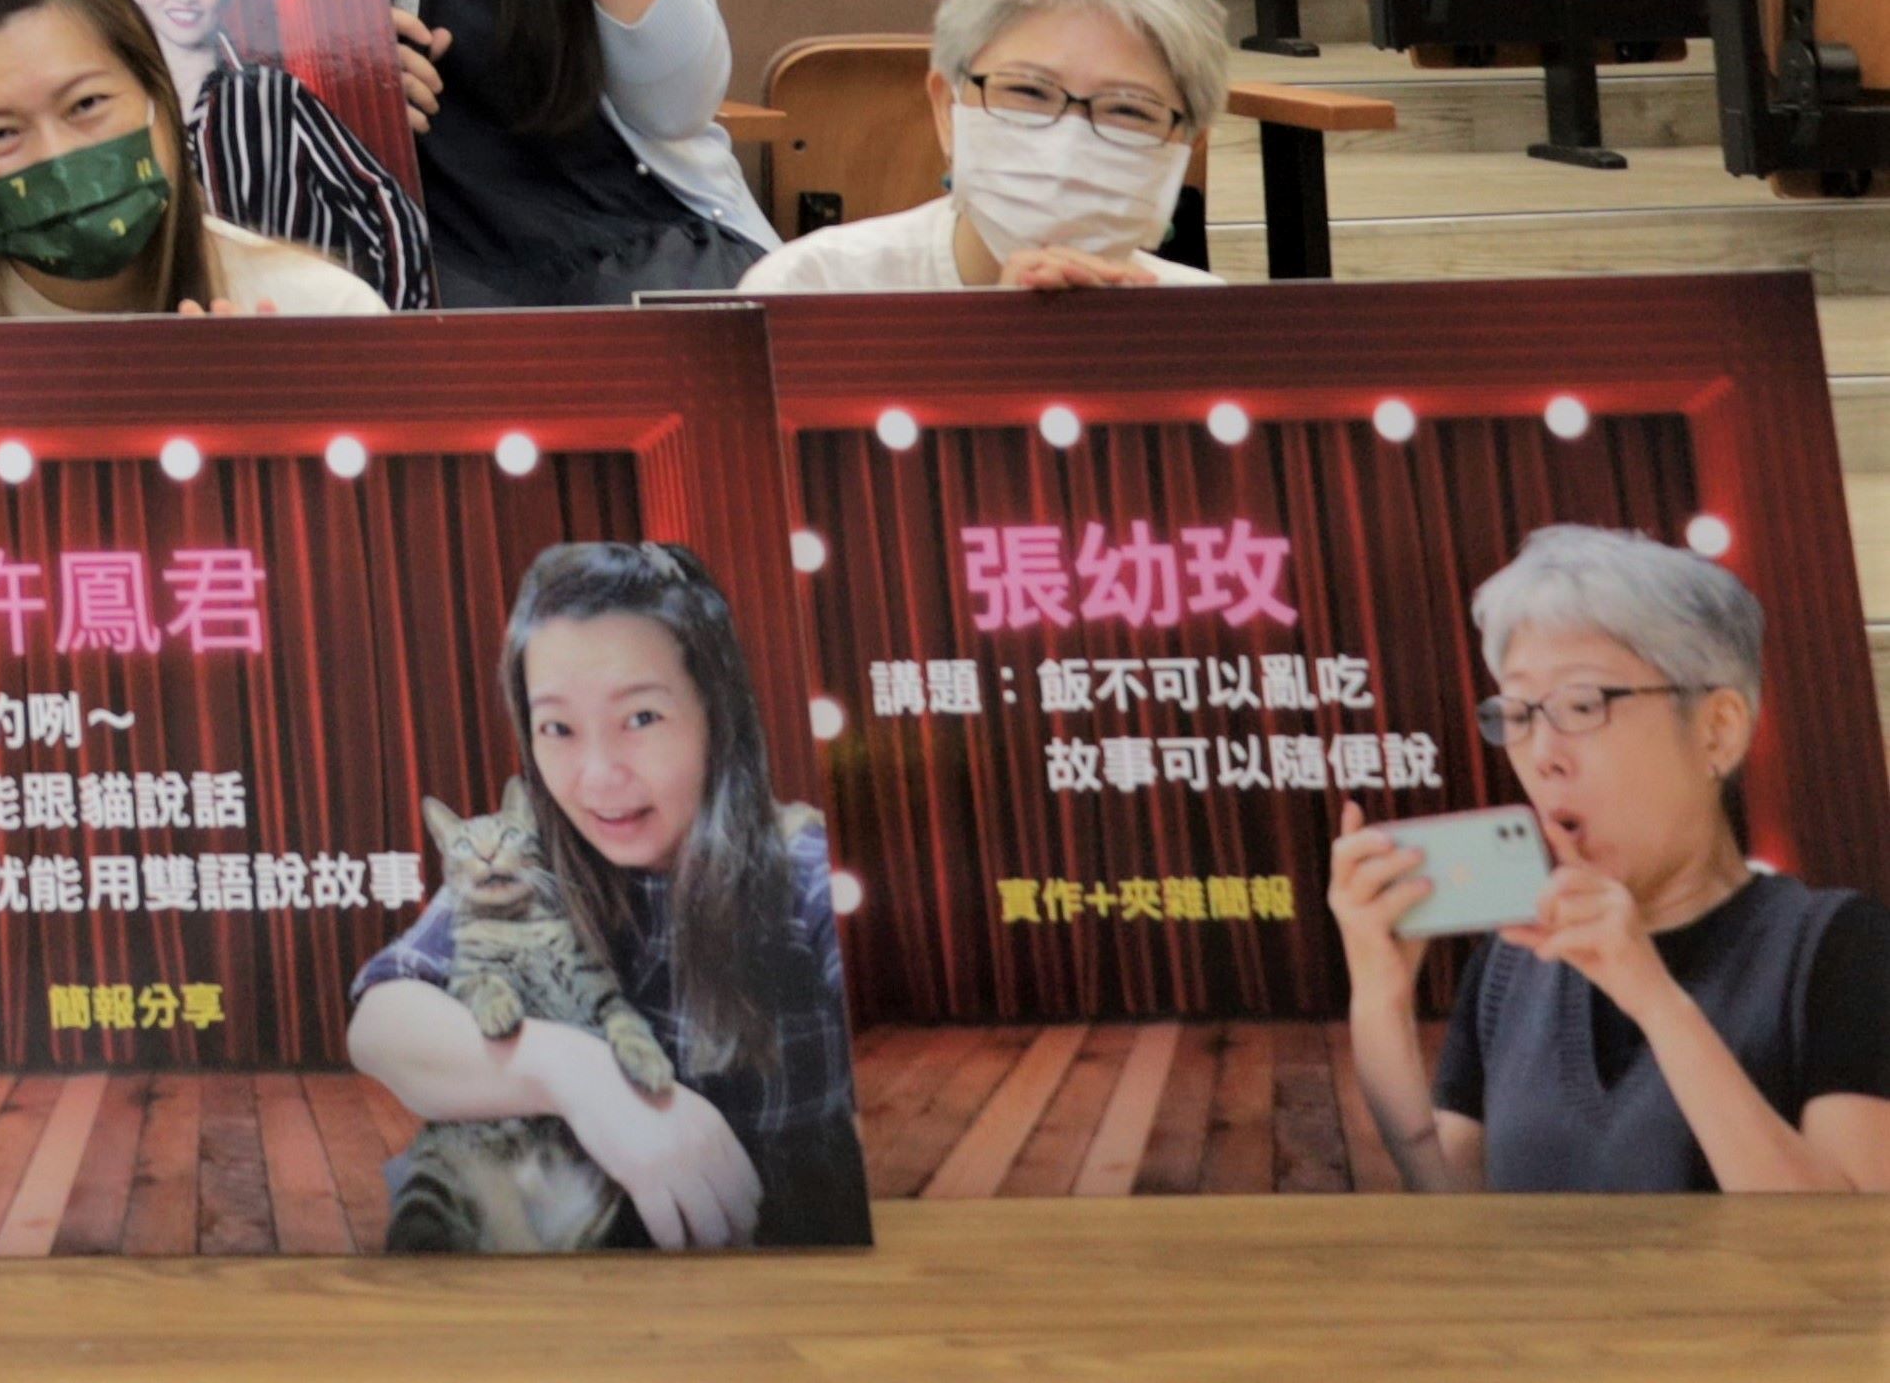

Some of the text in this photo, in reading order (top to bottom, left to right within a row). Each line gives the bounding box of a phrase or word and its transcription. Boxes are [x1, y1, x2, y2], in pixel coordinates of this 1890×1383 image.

[962, 520, 1295, 629] 張幼玫
[1046, 733, 1440, 791] 故事可以隨便說
[48, 983, 225, 1029] 簡報分享
